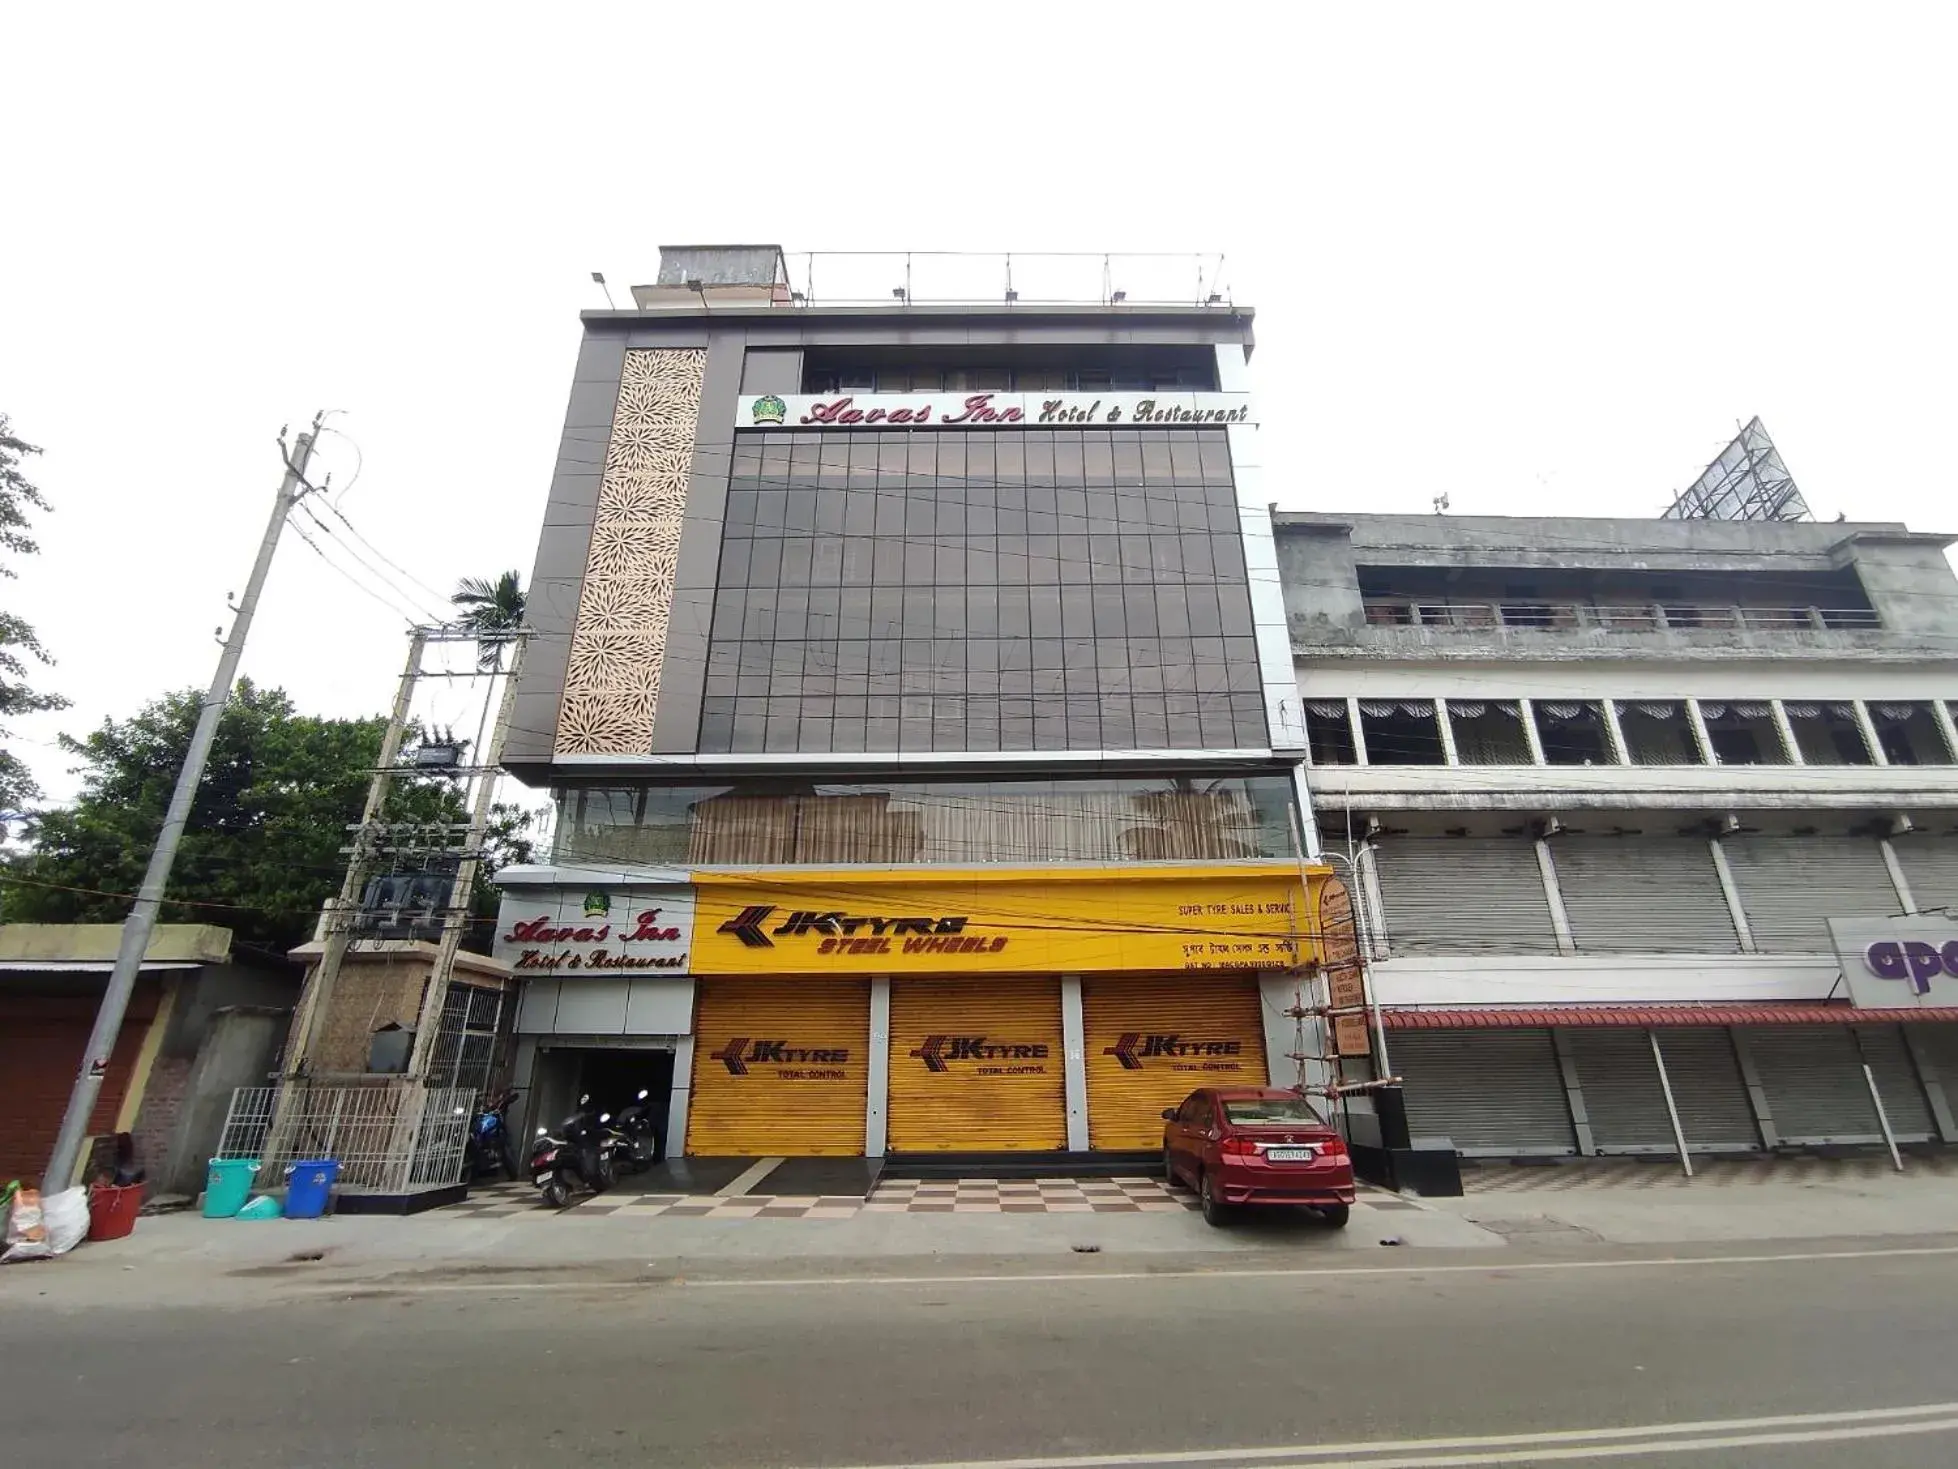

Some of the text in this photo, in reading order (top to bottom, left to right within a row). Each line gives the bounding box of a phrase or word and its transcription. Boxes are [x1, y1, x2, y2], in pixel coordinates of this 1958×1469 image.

[800, 394, 1248, 424] Aavas Inn Hotel & Restaurant
[1179, 905, 1203, 916] SUPER
[1207, 904, 1227, 915] TYRE
[1231, 904, 1254, 915] SALES
[1266, 903, 1296, 914] SERVIC
[504, 908, 681, 942] Aavas Inn
[817, 936, 1008, 954] STEEL WHEELS
[514, 950, 687, 969] Hotel & Restaurant
[779, 1070, 846, 1079] TOTAL CONTROL
[977, 1065, 1048, 1075] TOTAL CONTROL
[1203, 1062, 1242, 1072] CONTROL
